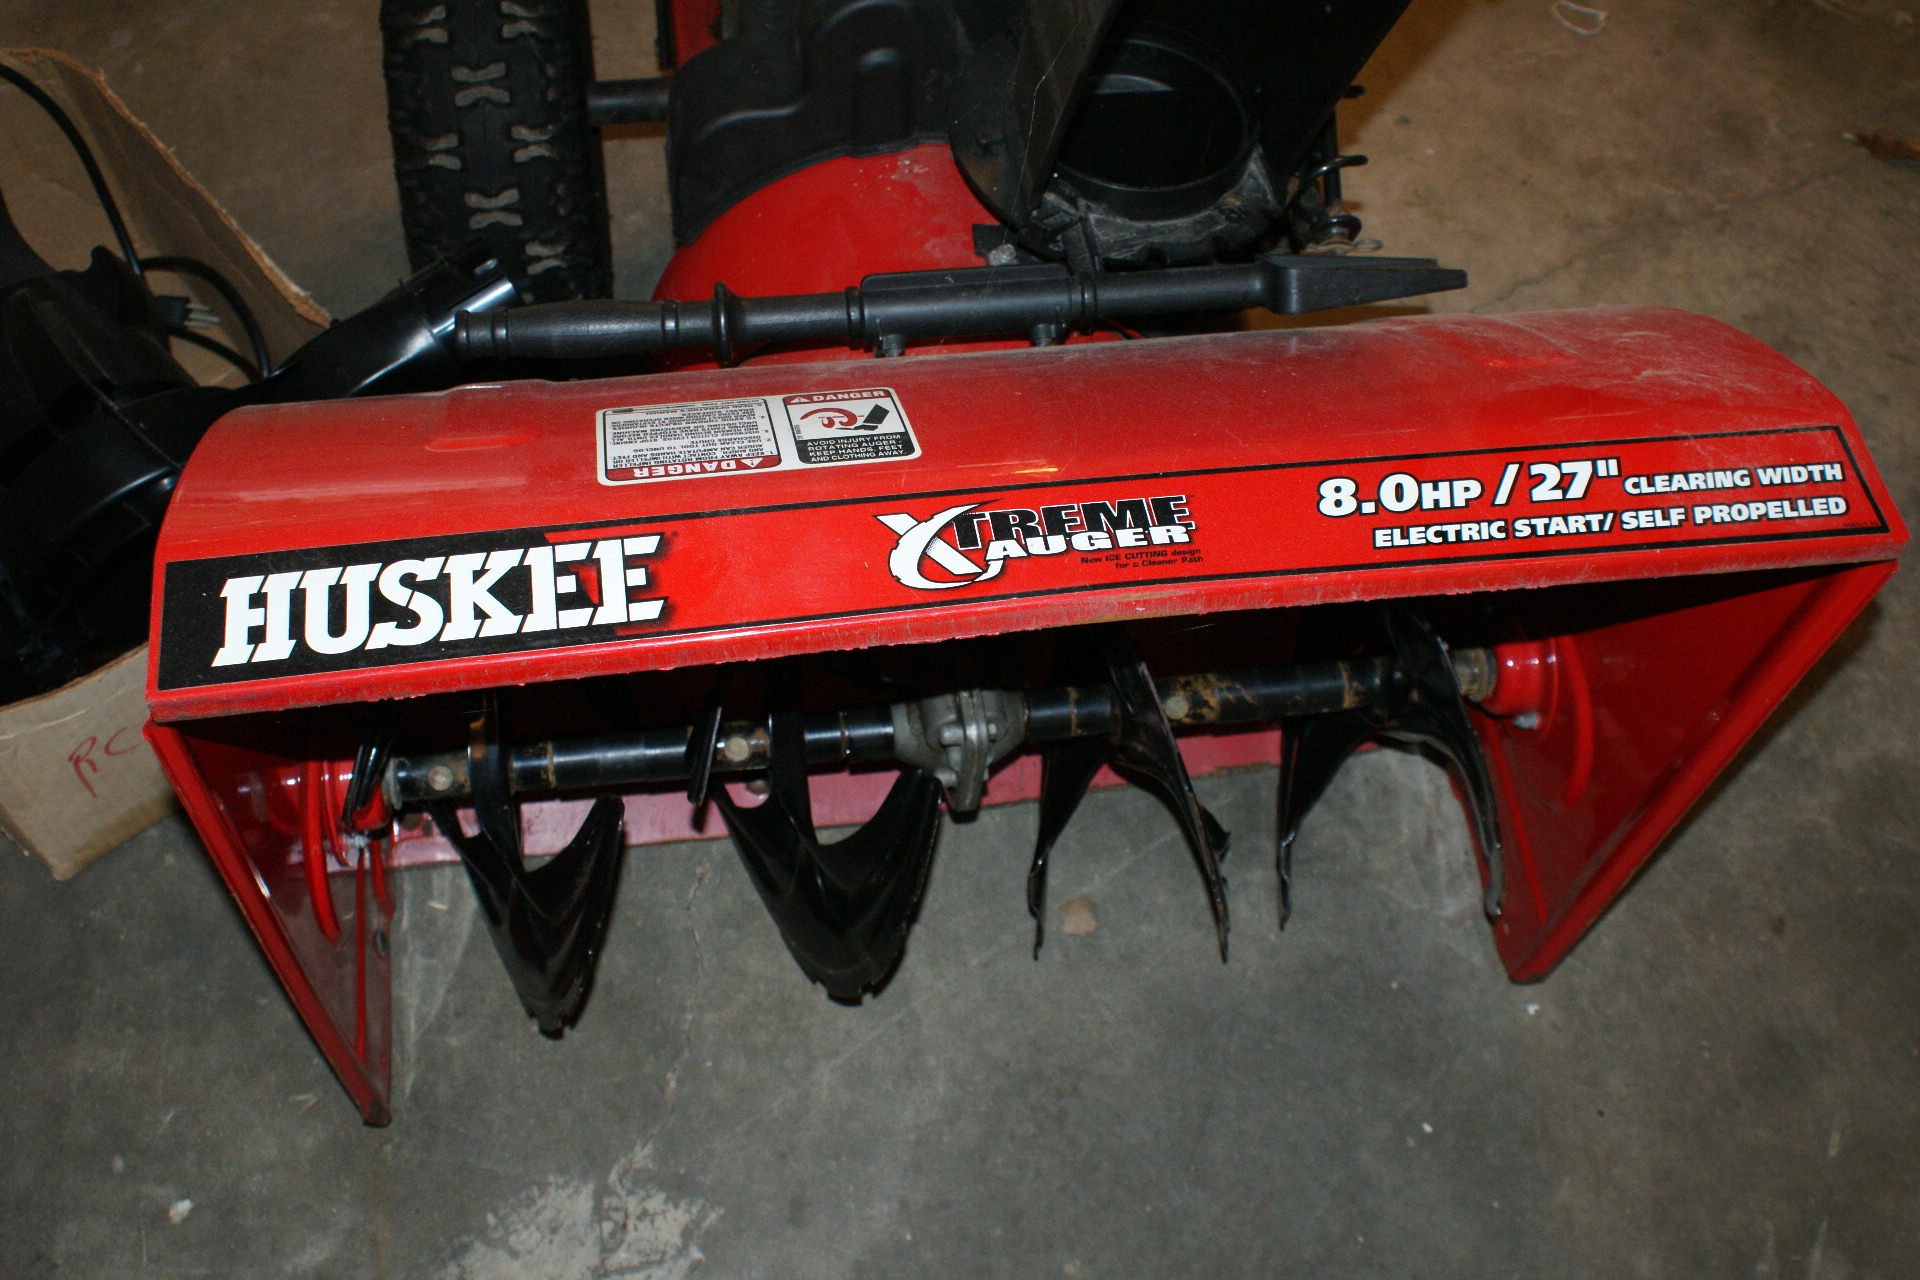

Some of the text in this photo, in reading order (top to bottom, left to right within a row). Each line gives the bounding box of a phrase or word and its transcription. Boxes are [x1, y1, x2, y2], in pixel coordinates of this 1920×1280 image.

[812, 391, 885, 401] DANGER
[807, 443, 859, 452] ROTATING
[831, 452, 876, 461] CLOTHING
[633, 460, 736, 477] DANGER
[1317, 476, 1482, 516] 8.0HP
[1624, 470, 1750, 494] CLEARING
[1758, 463, 1844, 485] WIDTH
[1374, 496, 1848, 548] ELECTRIC START/ SELF PROPELLED
[985, 525, 1191, 562] AUGER
[1080, 548, 1201, 564] New ICE CUTTING design
[1115, 561, 1129, 569] for
[1141, 558, 1178, 567] Cleaner
[1181, 555, 1204, 563] Path
[211, 535, 664, 667] HUSKEE
